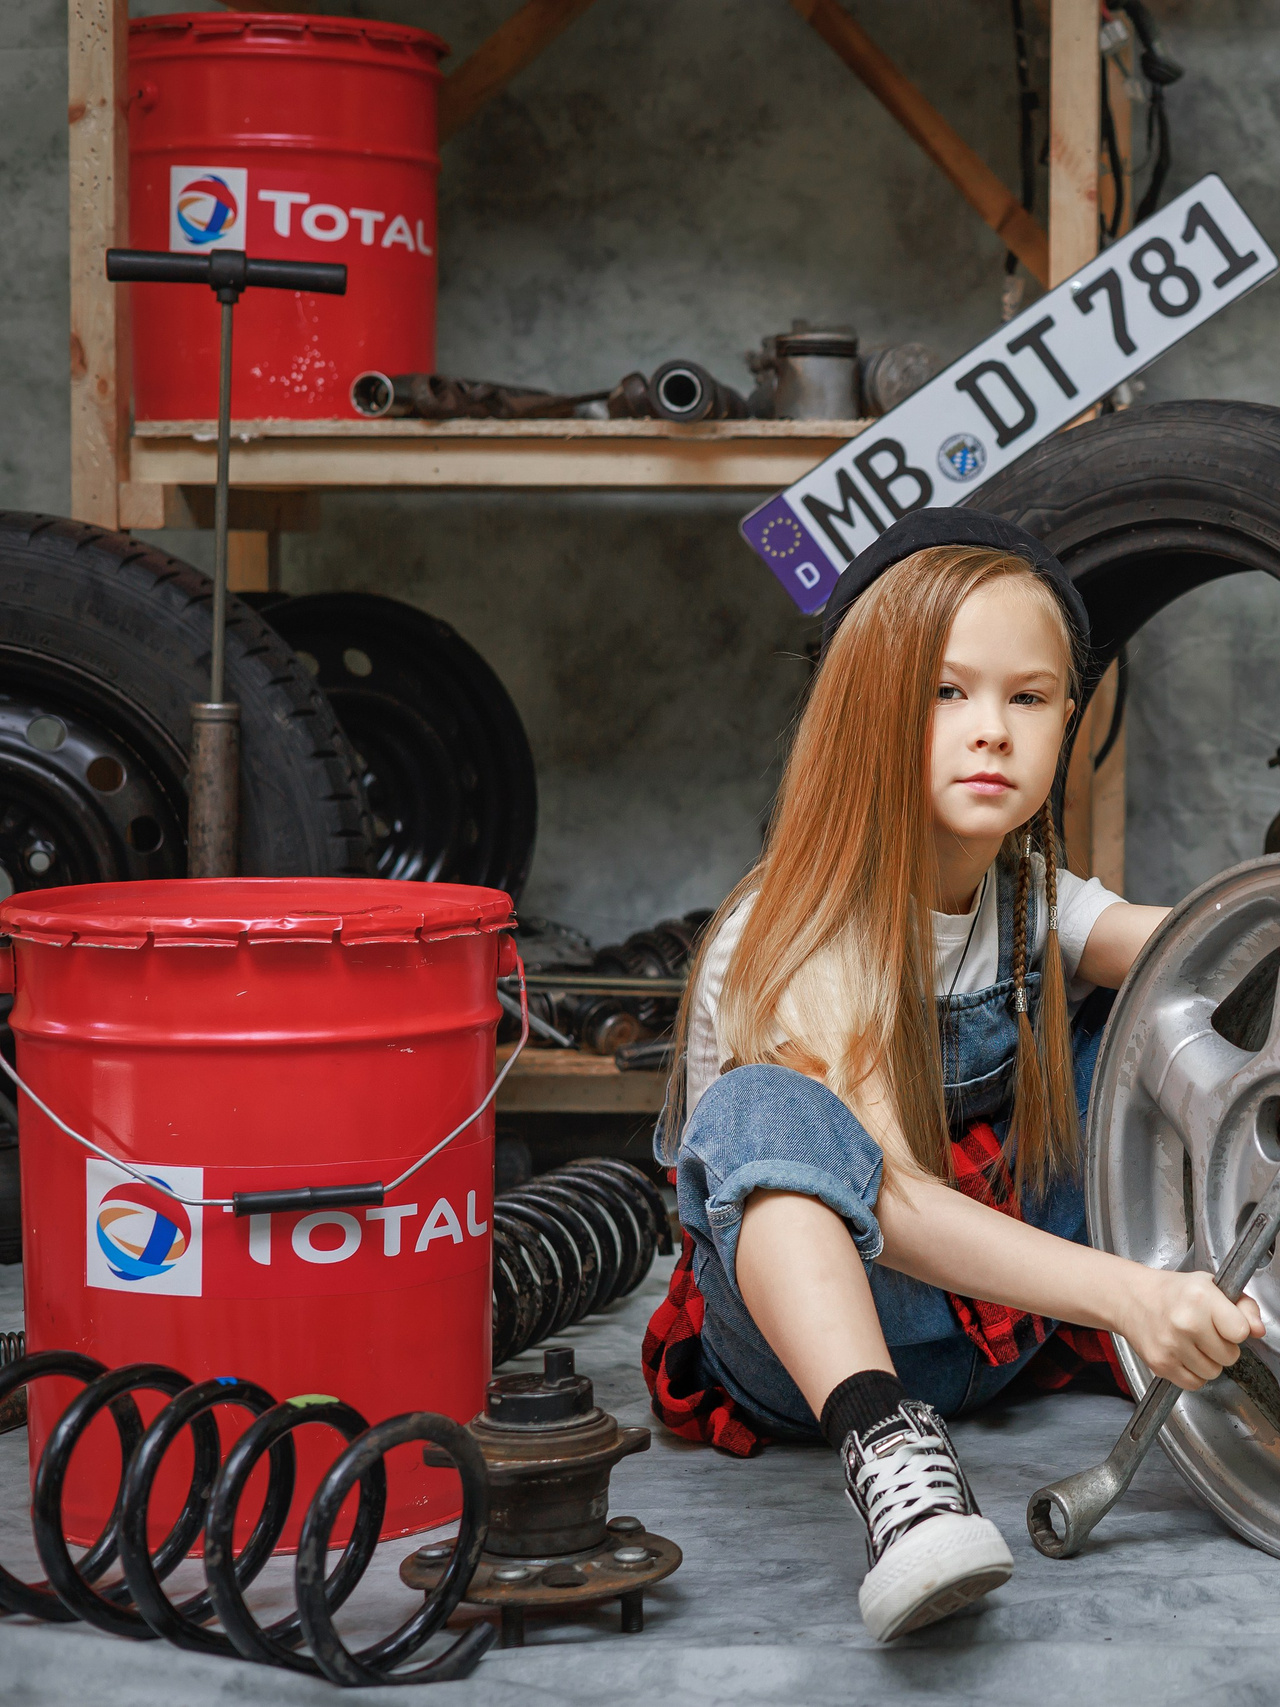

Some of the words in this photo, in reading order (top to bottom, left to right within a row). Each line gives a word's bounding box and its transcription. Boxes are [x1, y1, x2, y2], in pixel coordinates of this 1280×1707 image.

[258, 189, 433, 257] TOTAL
[801, 437, 934, 563] MB
[955, 315, 1079, 448] DT
[1073, 201, 1260, 357] 781
[794, 561, 821, 590] D
